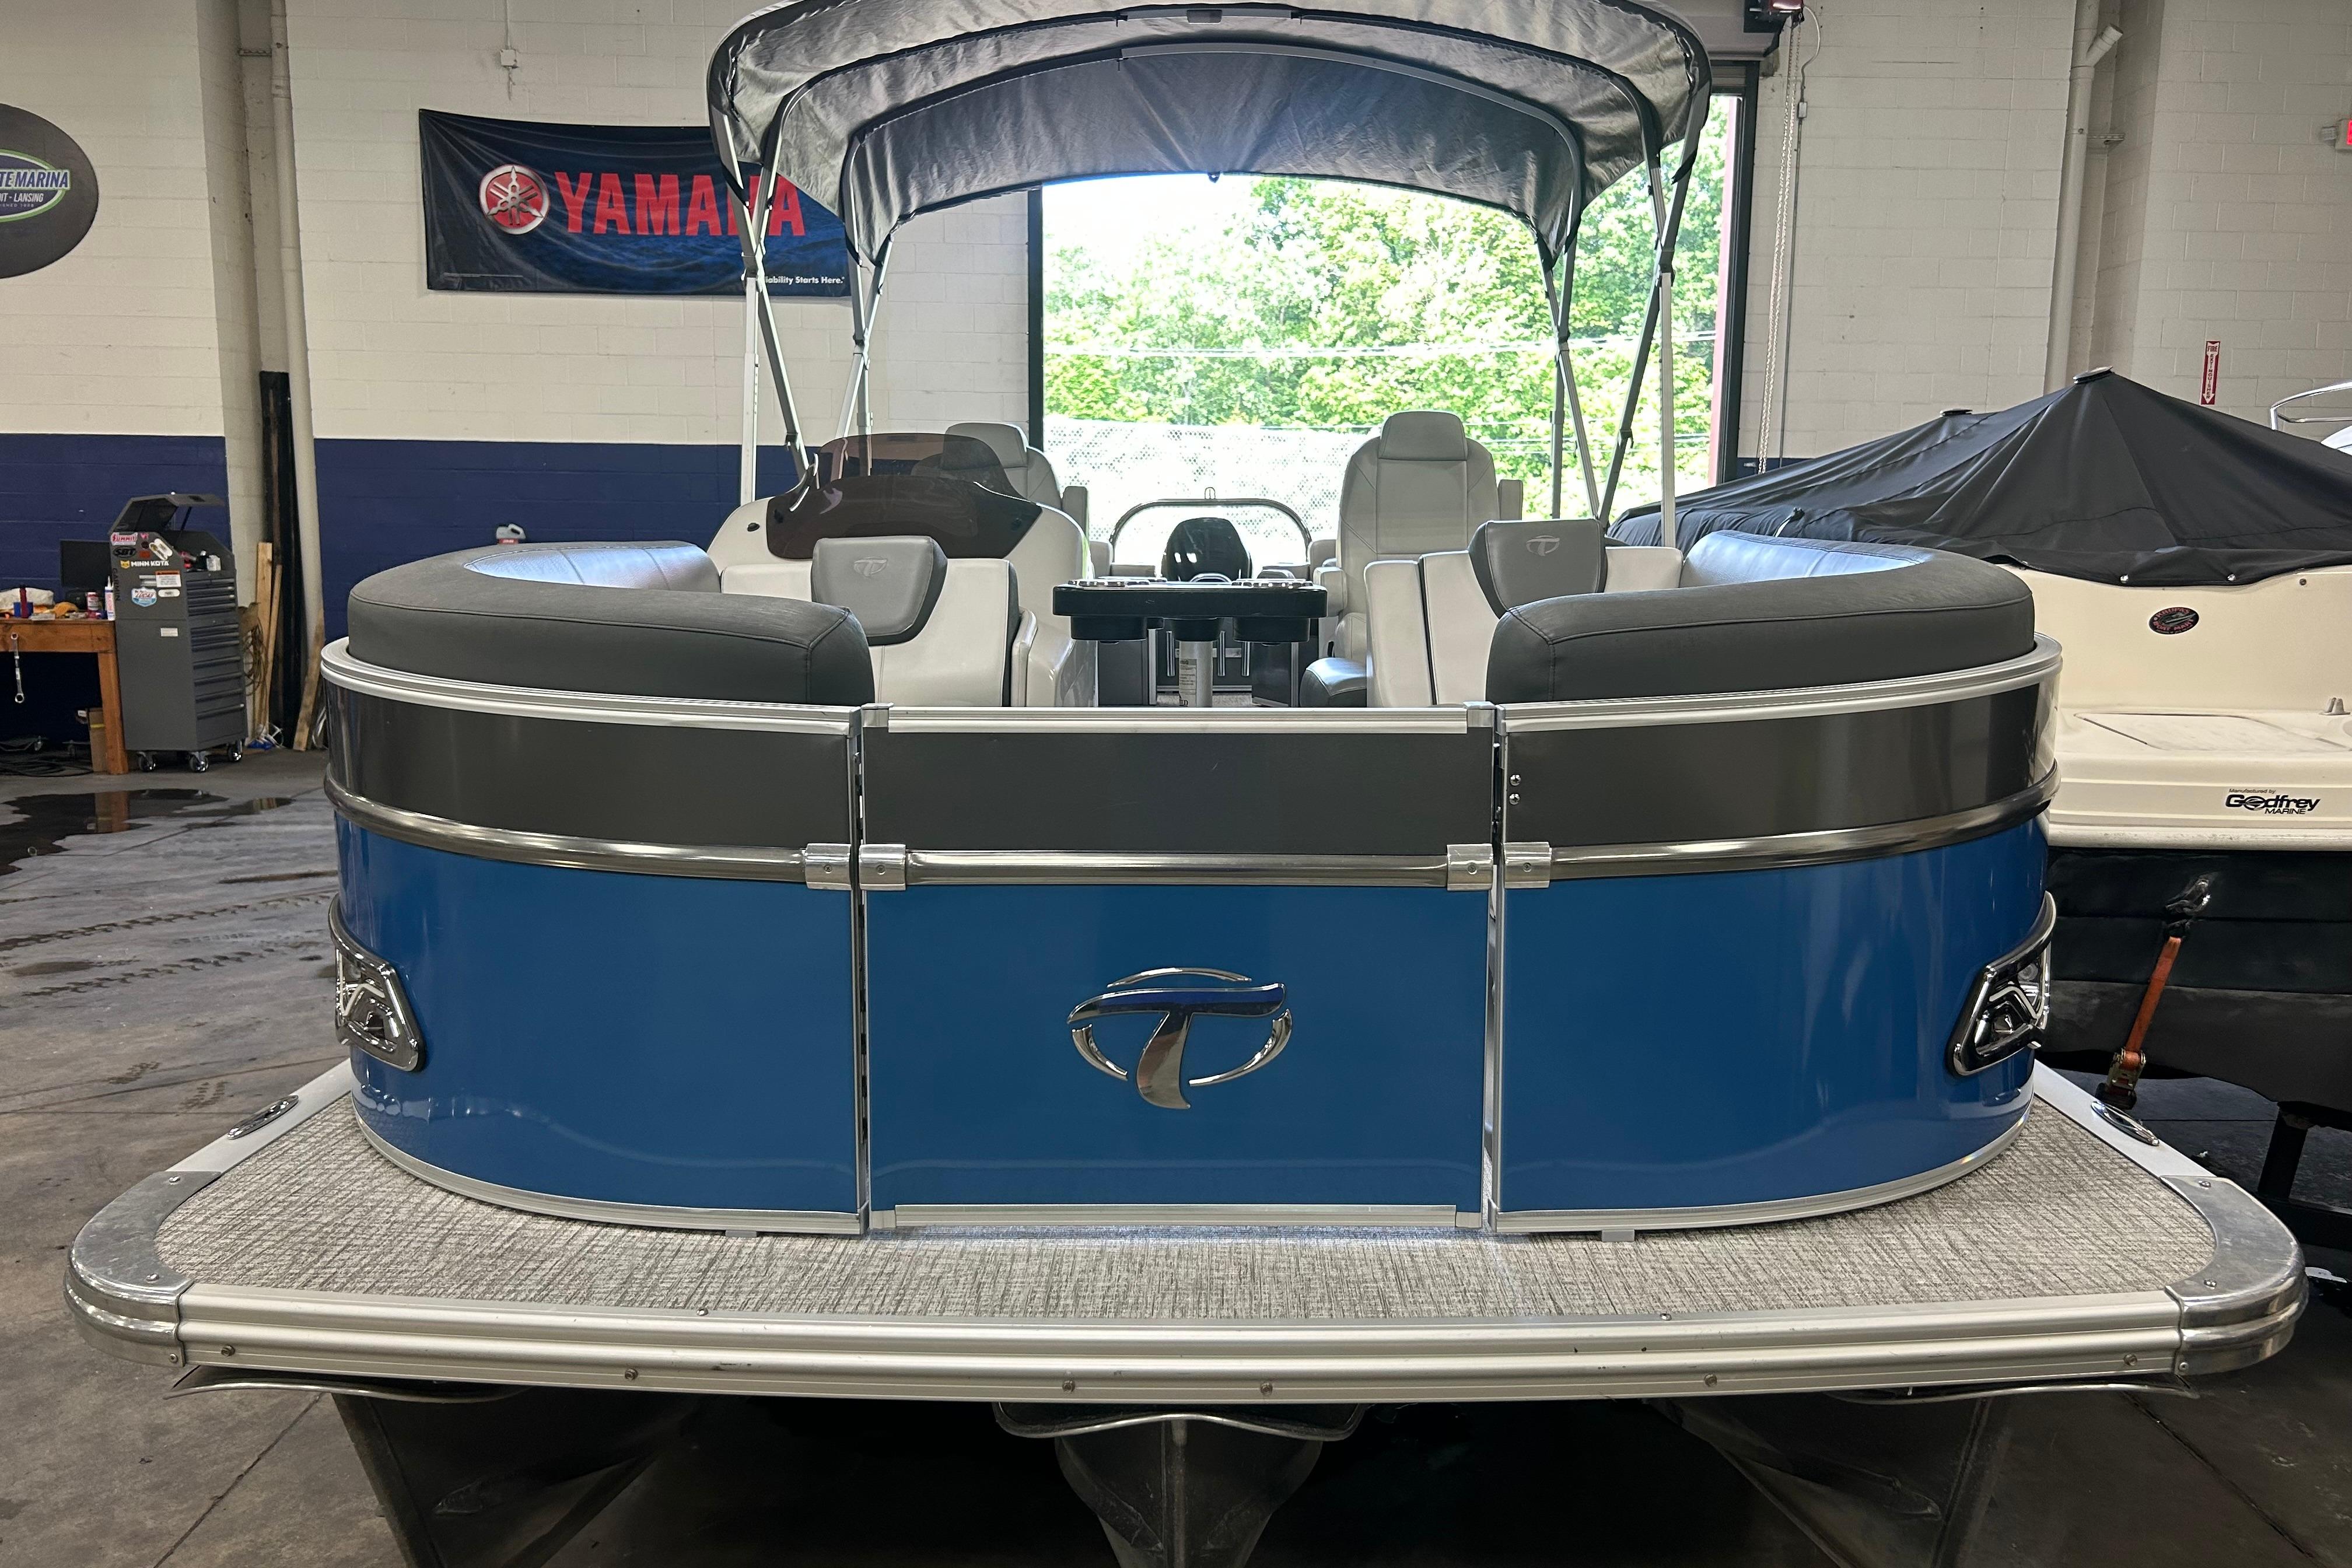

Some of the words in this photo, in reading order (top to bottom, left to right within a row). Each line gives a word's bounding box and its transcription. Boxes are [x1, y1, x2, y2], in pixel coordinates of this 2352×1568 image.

[15, 172, 68, 187] MARINA
[14, 192, 44, 202] LANSING
[2206, 354, 2214, 399] EXTINGUISHER
[2225, 794, 2321, 811] Godfrey
